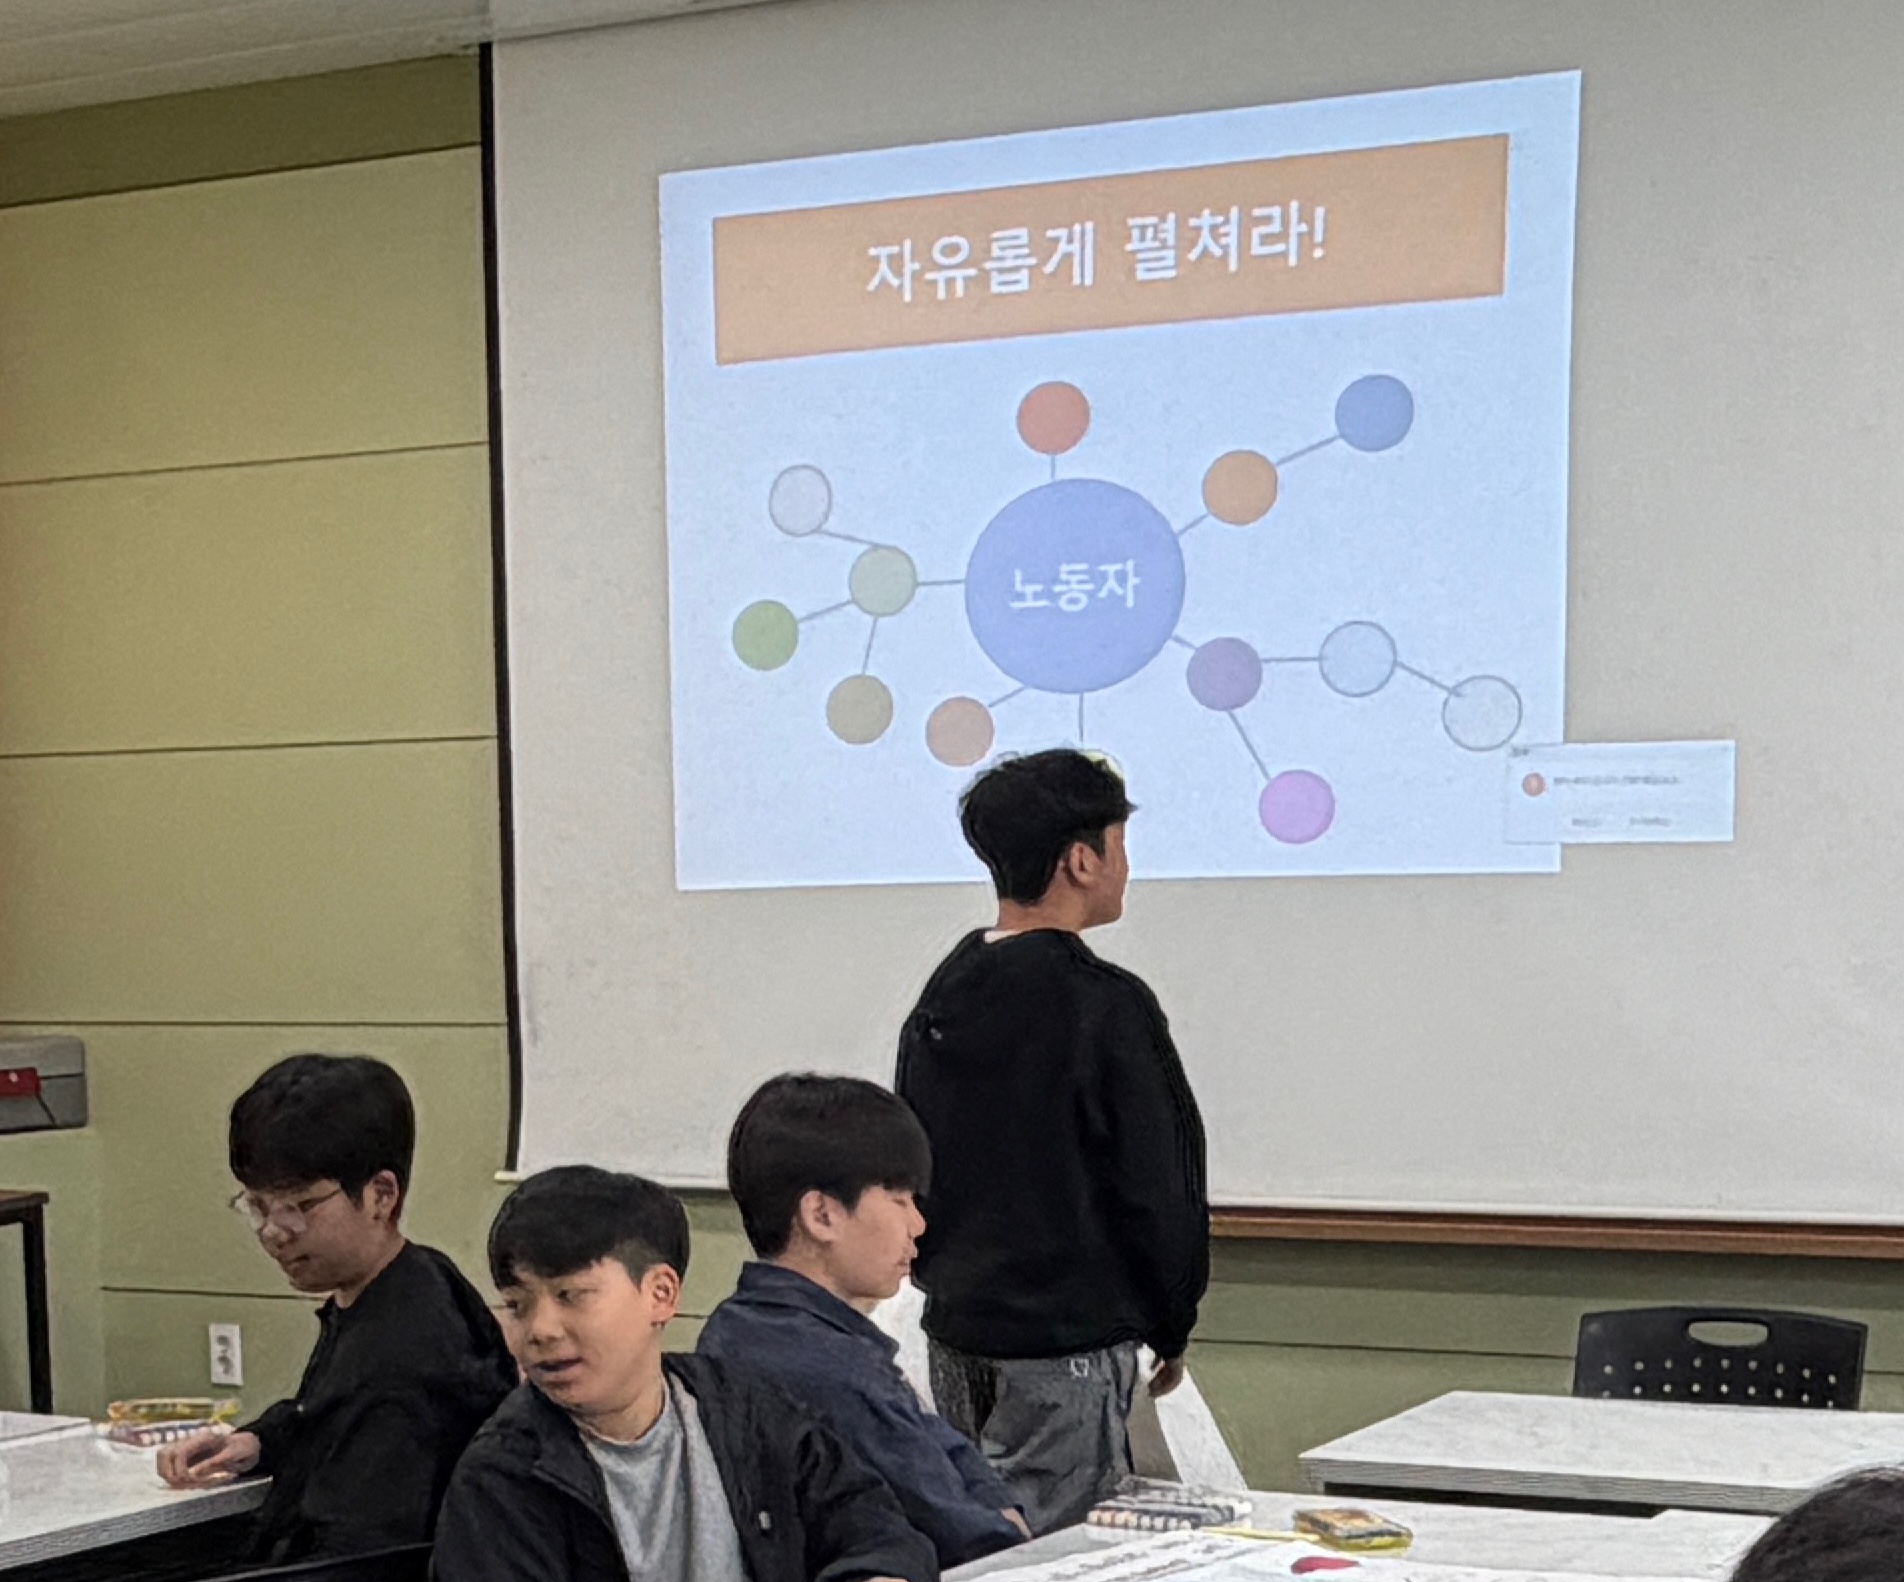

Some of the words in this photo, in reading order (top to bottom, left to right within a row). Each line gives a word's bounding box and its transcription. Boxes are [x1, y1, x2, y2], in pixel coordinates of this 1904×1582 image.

[866, 220, 1095, 302] 자유롭게
[1124, 199, 1327, 281] 펼쳐라!
[1008, 558, 1142, 613] 노동자
